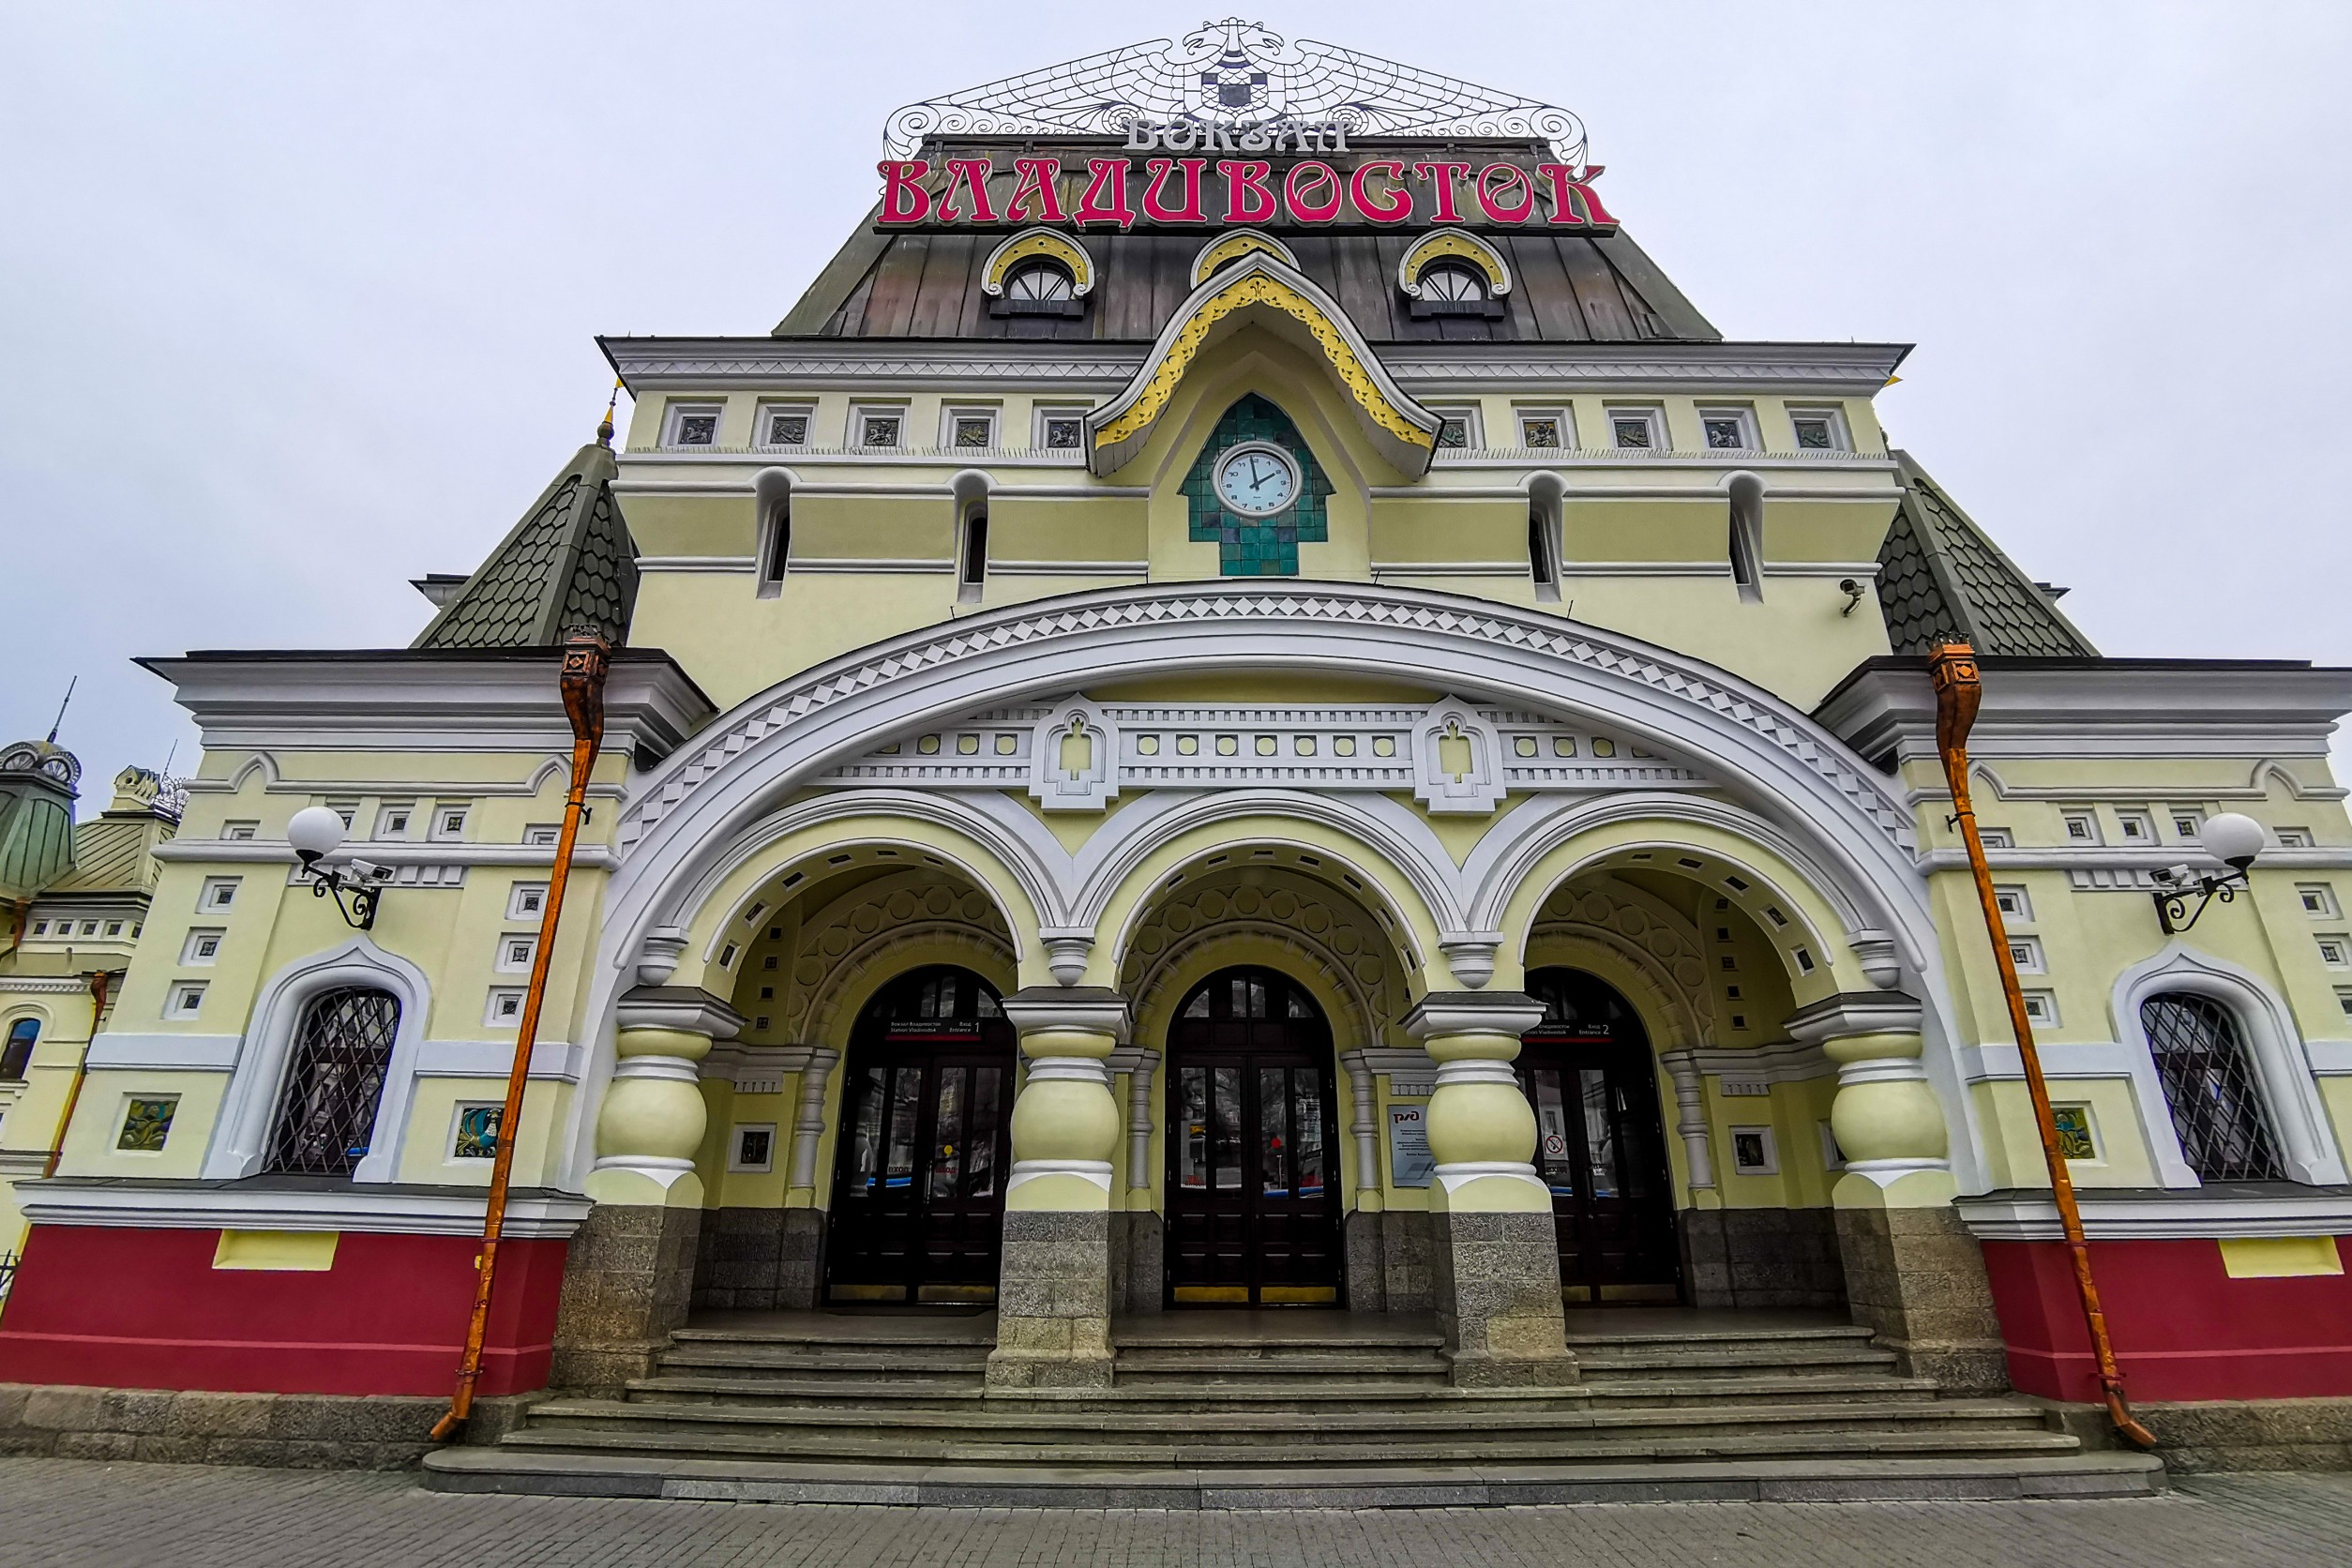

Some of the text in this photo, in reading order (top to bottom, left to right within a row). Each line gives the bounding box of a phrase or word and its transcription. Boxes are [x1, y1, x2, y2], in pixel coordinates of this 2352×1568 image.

[1123, 119, 1355, 156] ВОКЗАЛ
[875, 158, 1621, 231] ВЛАДИВОСТОК
[975, 1022, 979, 1033] 1
[1603, 1024, 1609, 1034] 2
